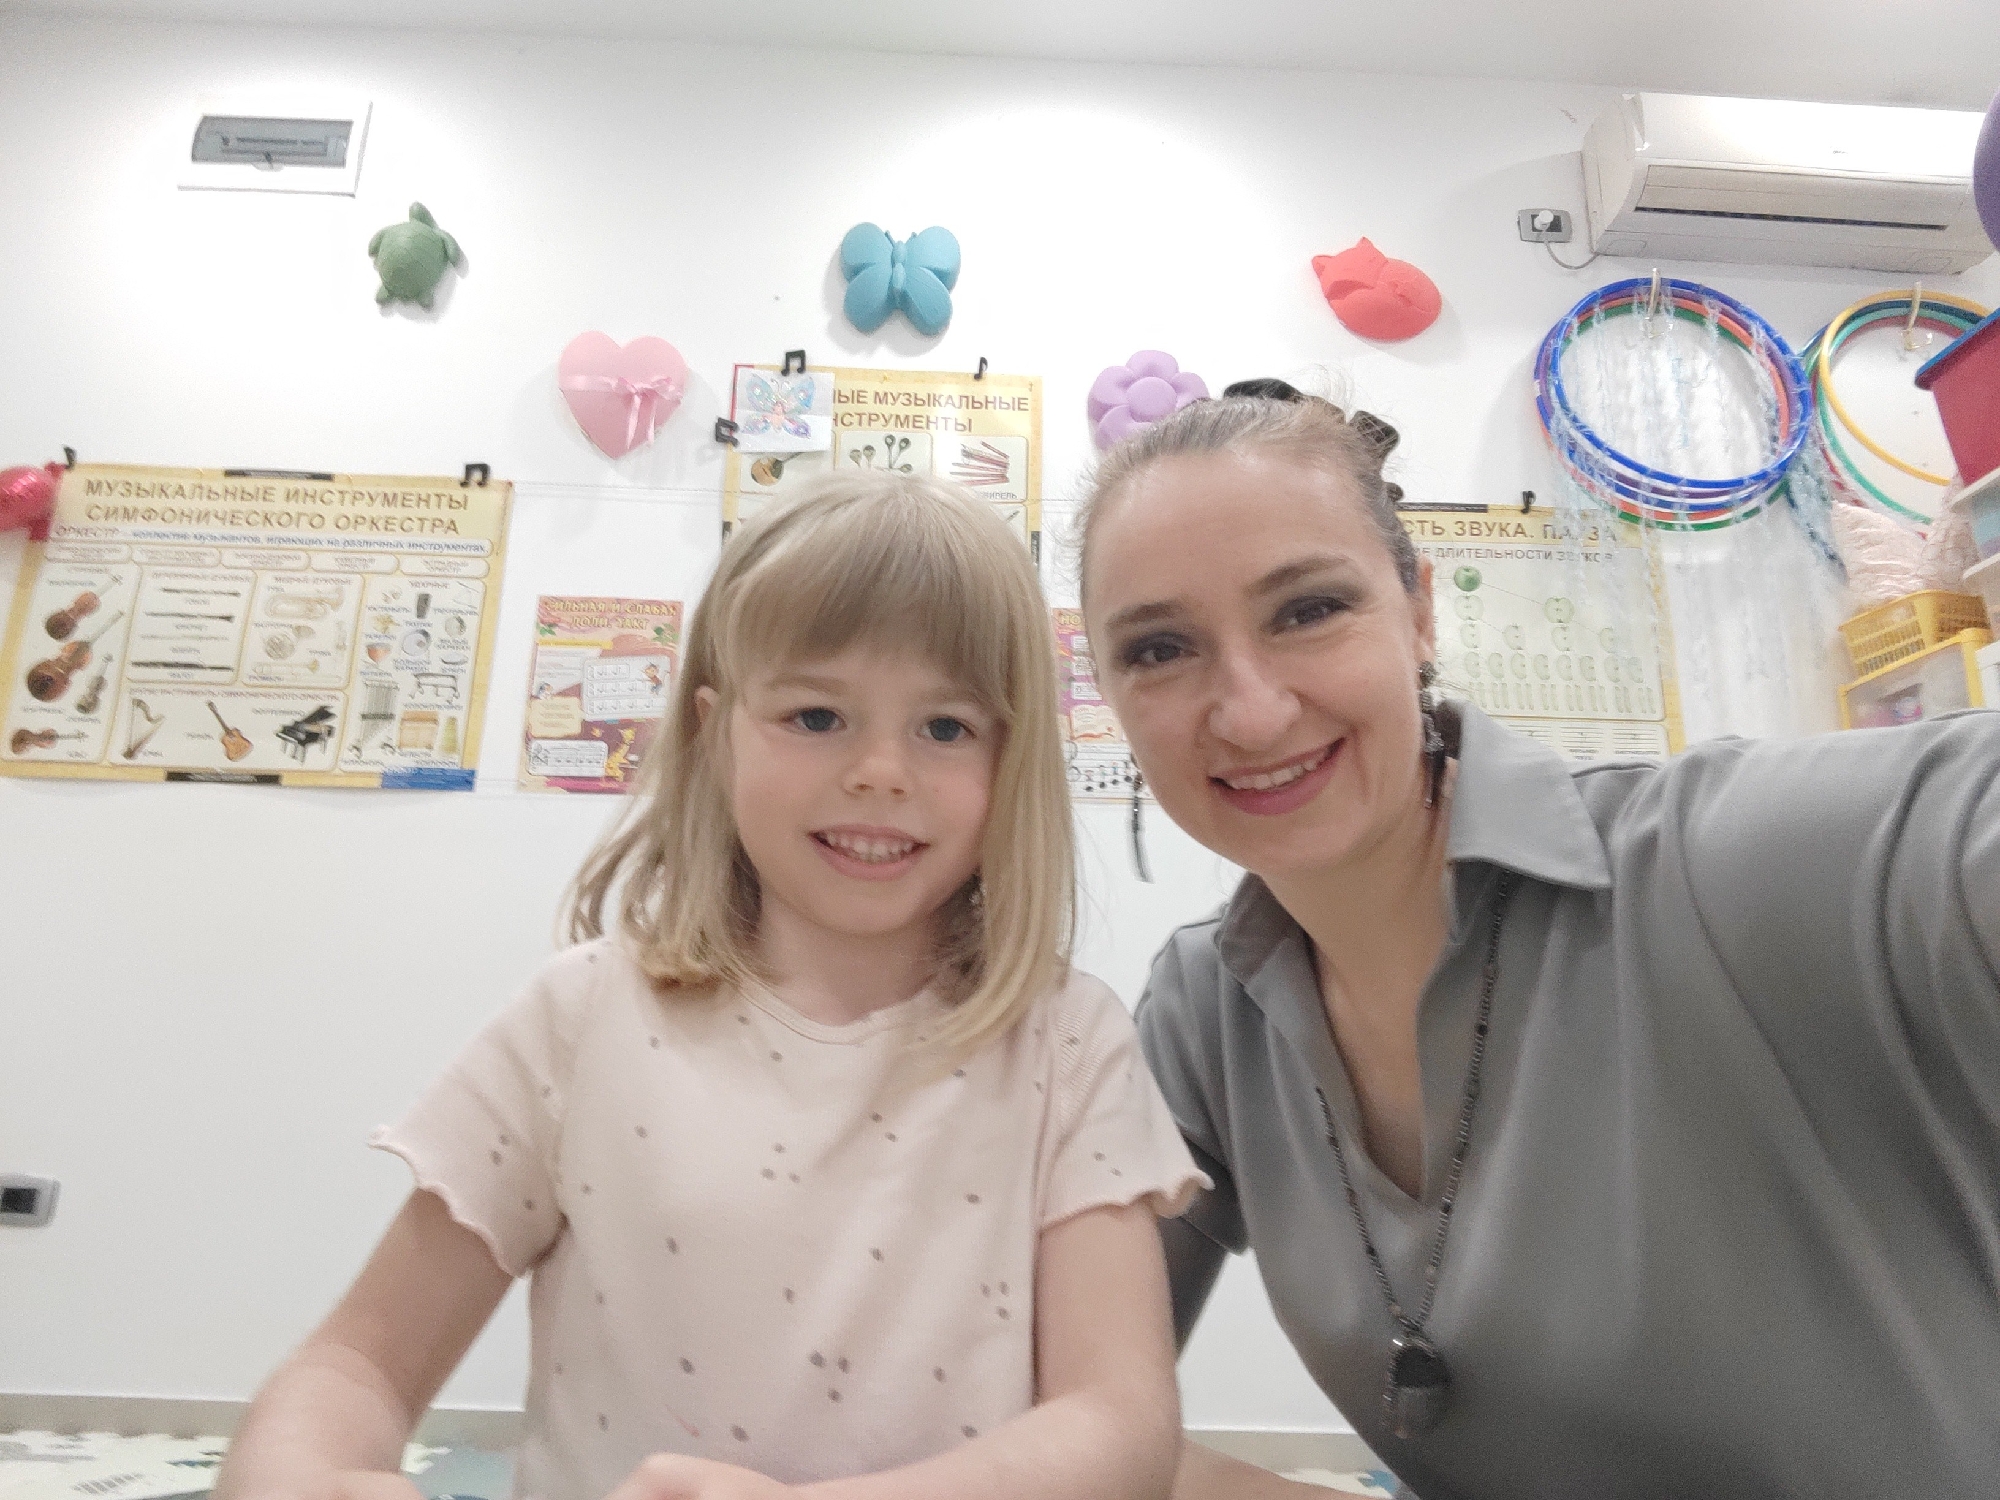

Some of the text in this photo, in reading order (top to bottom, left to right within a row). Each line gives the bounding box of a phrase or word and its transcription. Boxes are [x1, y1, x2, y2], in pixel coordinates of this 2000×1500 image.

[874, 390, 1029, 411] МУЗЫКАЛЬНЫЕ
[85, 478, 469, 511] МУЗЫКАЛЬНЫЕ ИНСТРУМЕНТЫ
[85, 503, 460, 535] СИМФОНИЧЕСКОГО ОРКЕСТРА
[1454, 520, 1534, 538] ЗВУКА.
[1436, 547, 1552, 560] ДЛИТЕЛЬНОСТИ
